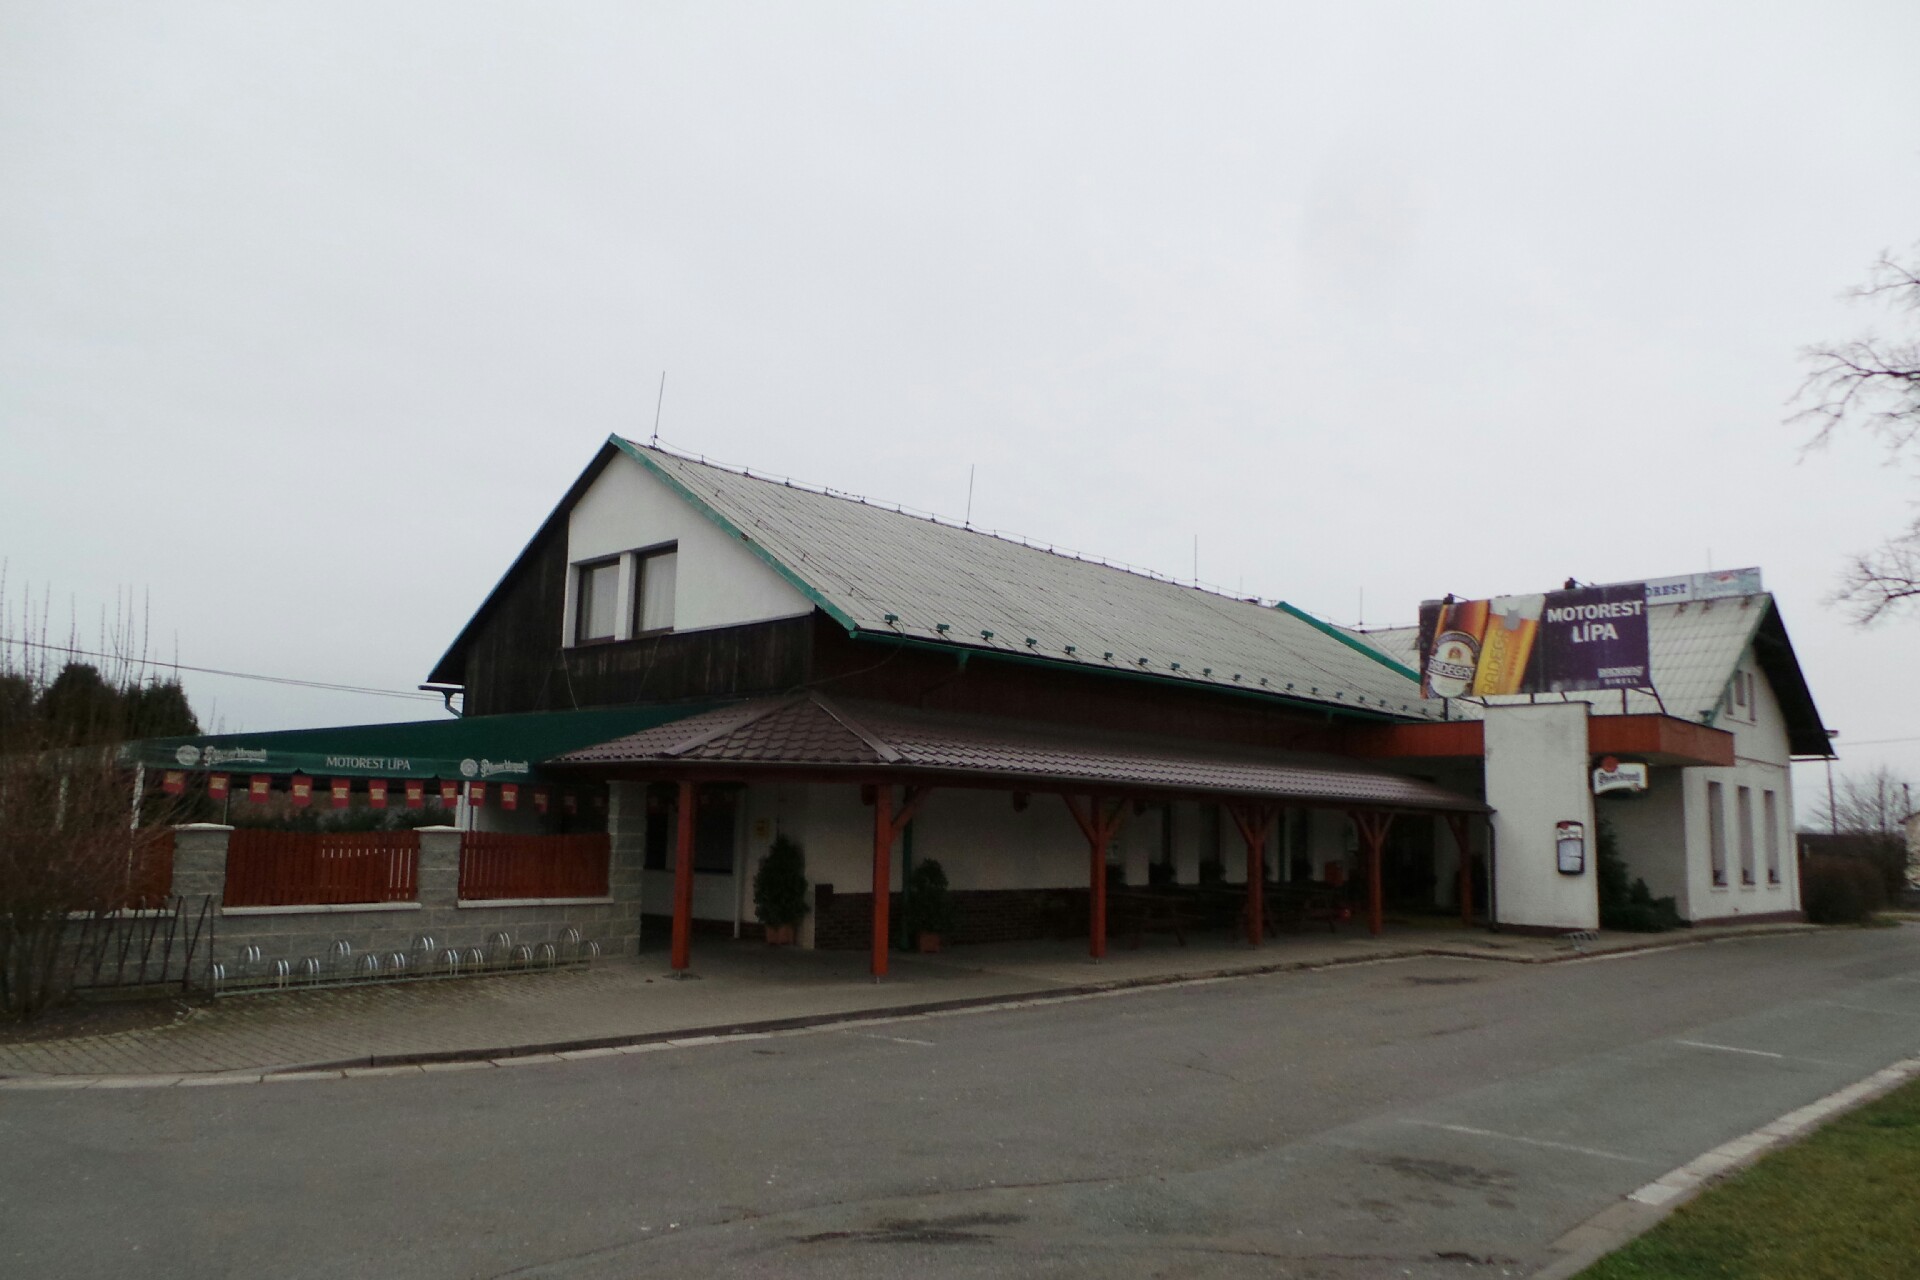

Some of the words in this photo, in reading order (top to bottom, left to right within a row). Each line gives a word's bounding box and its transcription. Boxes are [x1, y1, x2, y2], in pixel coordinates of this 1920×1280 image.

[1547, 600, 1644, 623] MOTOREST
[1572, 621, 1619, 643] LÍPA
[326, 756, 384, 769] MOTOREST
